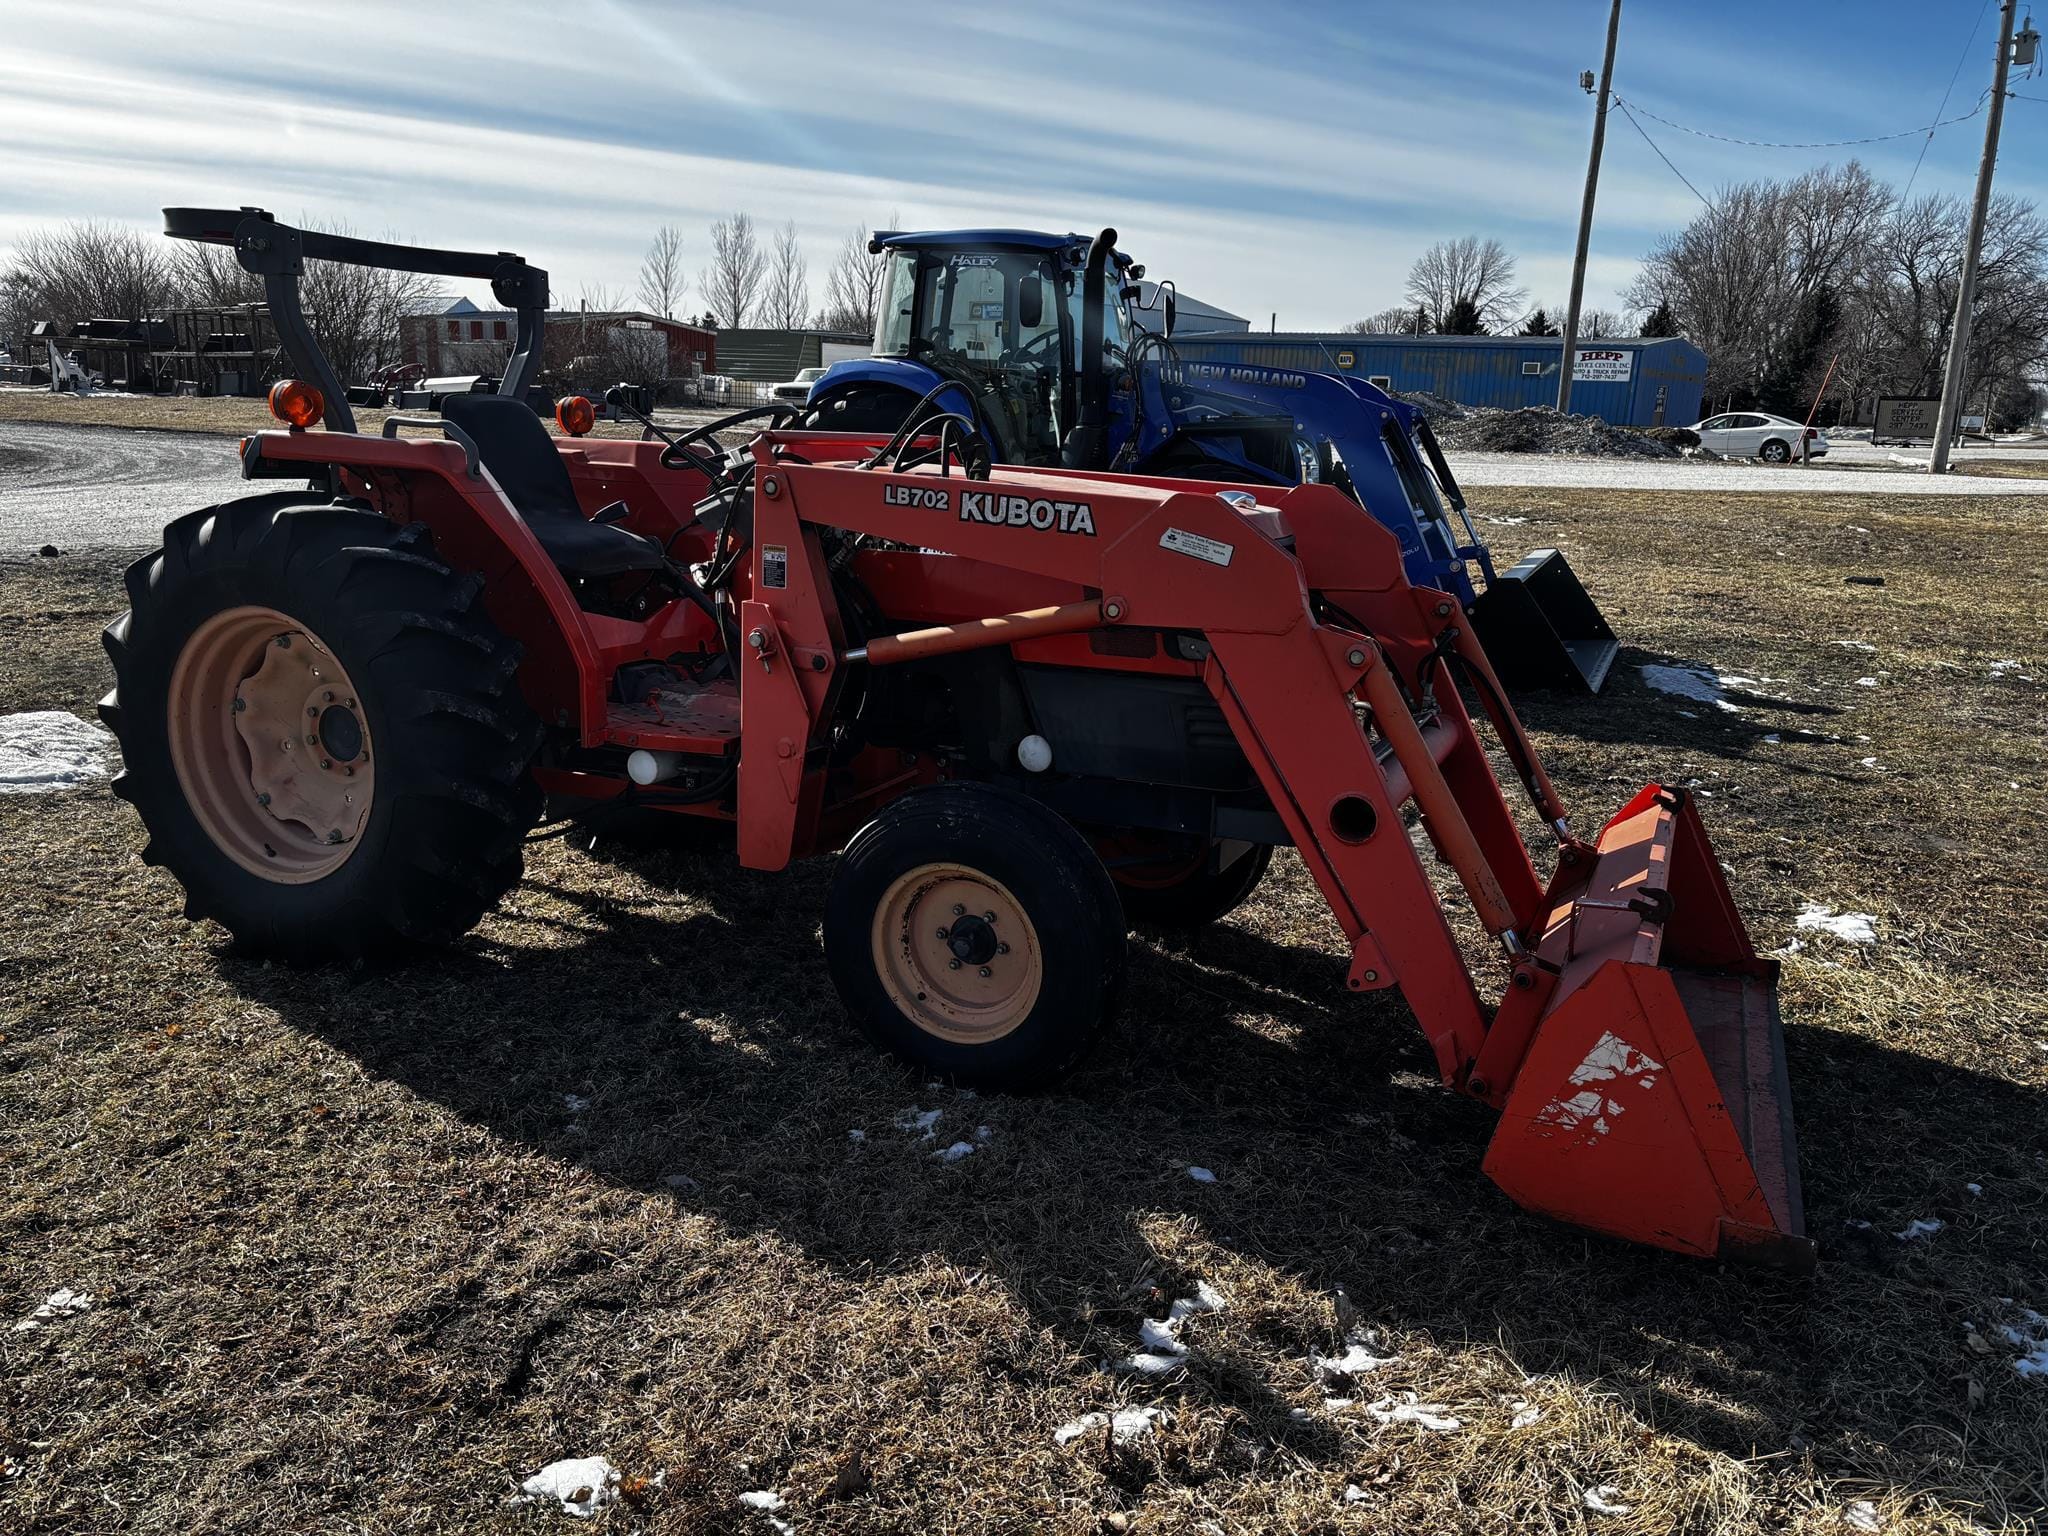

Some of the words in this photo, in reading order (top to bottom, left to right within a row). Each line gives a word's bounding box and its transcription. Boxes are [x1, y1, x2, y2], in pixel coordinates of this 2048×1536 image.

[950, 255, 999, 266] HALEY
[1580, 351, 1623, 361] HEPP
[1188, 364, 1226, 380] NEW
[1230, 368, 1306, 389] HOLLAND
[884, 484, 950, 511] LB702
[959, 490, 1097, 536] KUBOTA
